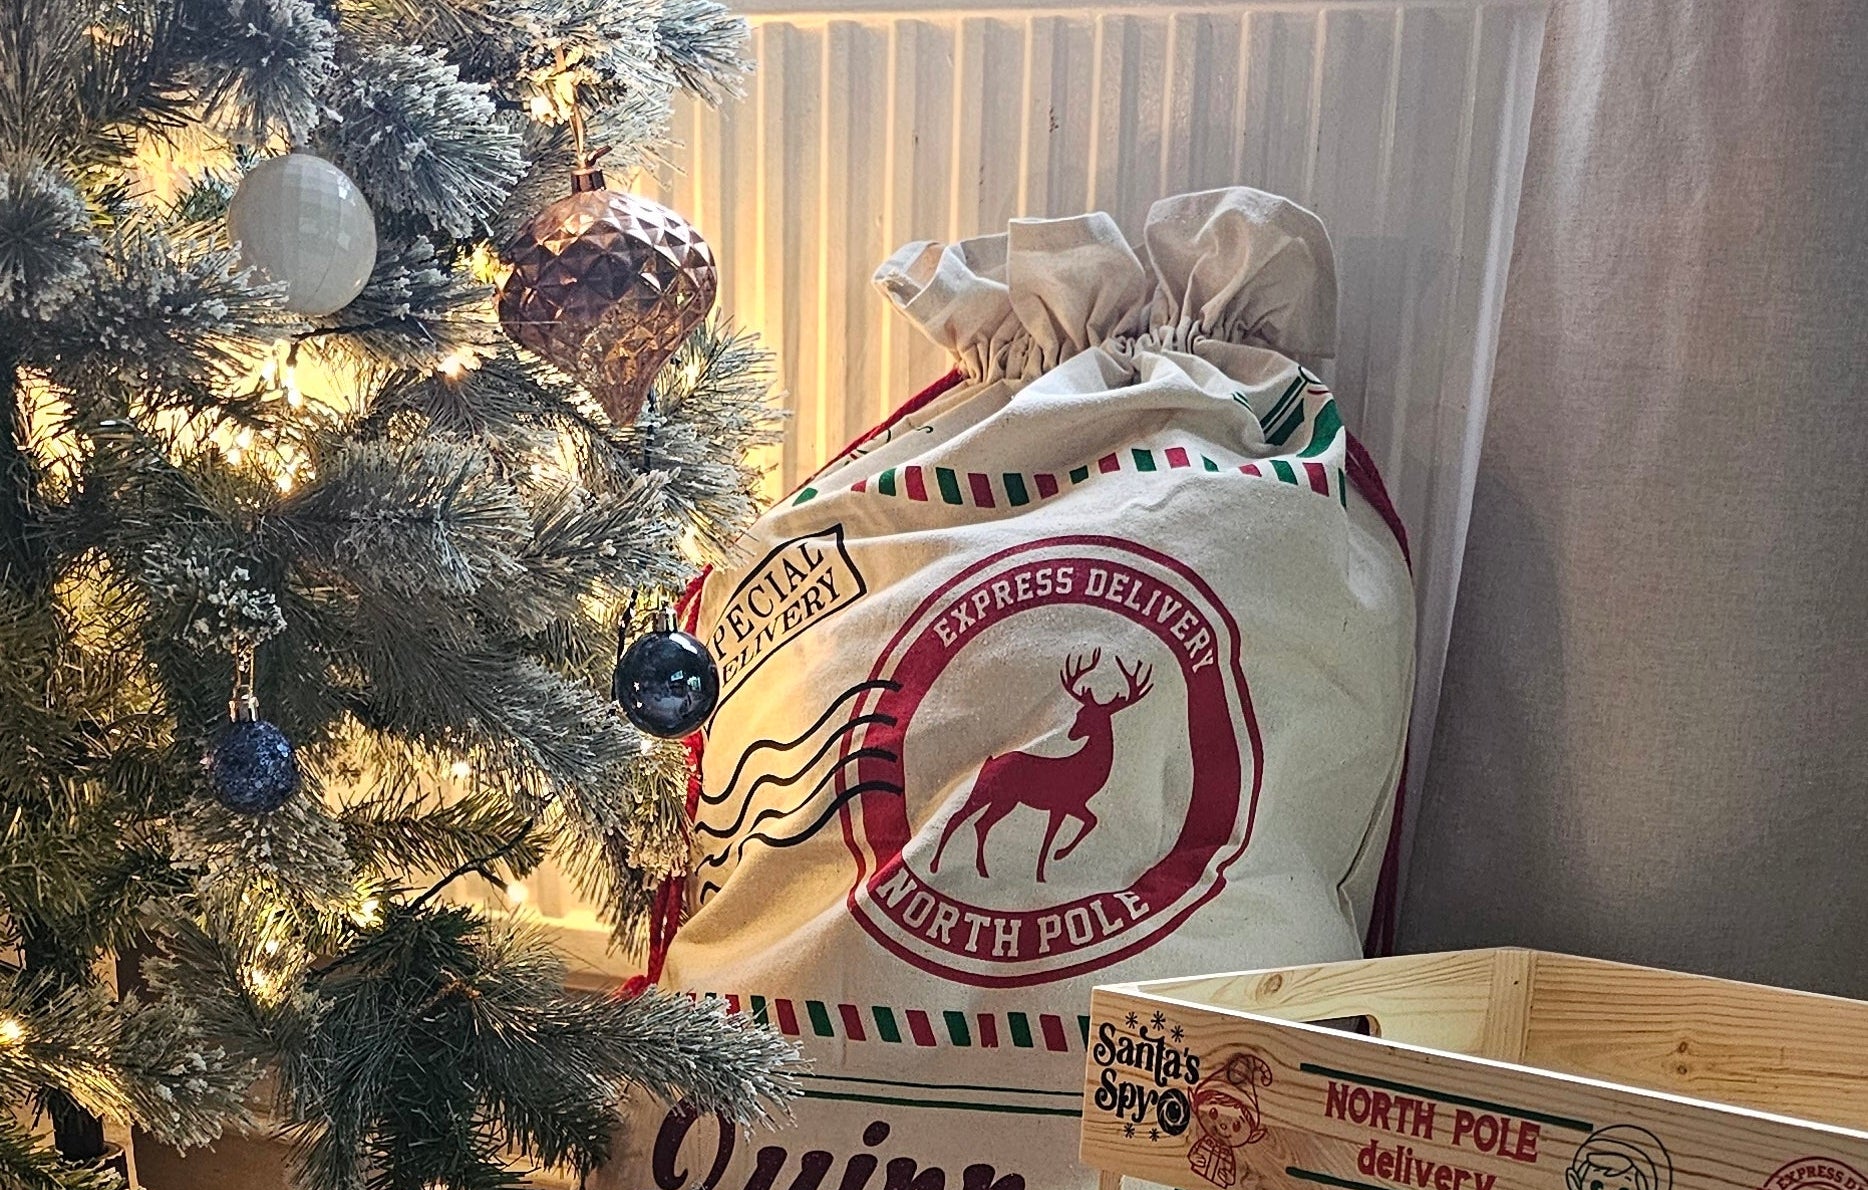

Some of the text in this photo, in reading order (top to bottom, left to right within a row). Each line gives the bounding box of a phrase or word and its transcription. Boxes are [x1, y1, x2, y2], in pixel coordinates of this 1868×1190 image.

[712, 543, 824, 661] PECIAL
[722, 566, 841, 687] ELIVERY
[933, 567, 1214, 673] EXPRESS DELIVERY
[876, 867, 1150, 957] NORTH POLE
[1094, 1022, 1199, 1086] Santa's
[1324, 1081, 1541, 1163] NORTH POLE
[1776, 1165, 1844, 1190] EXPRESS
